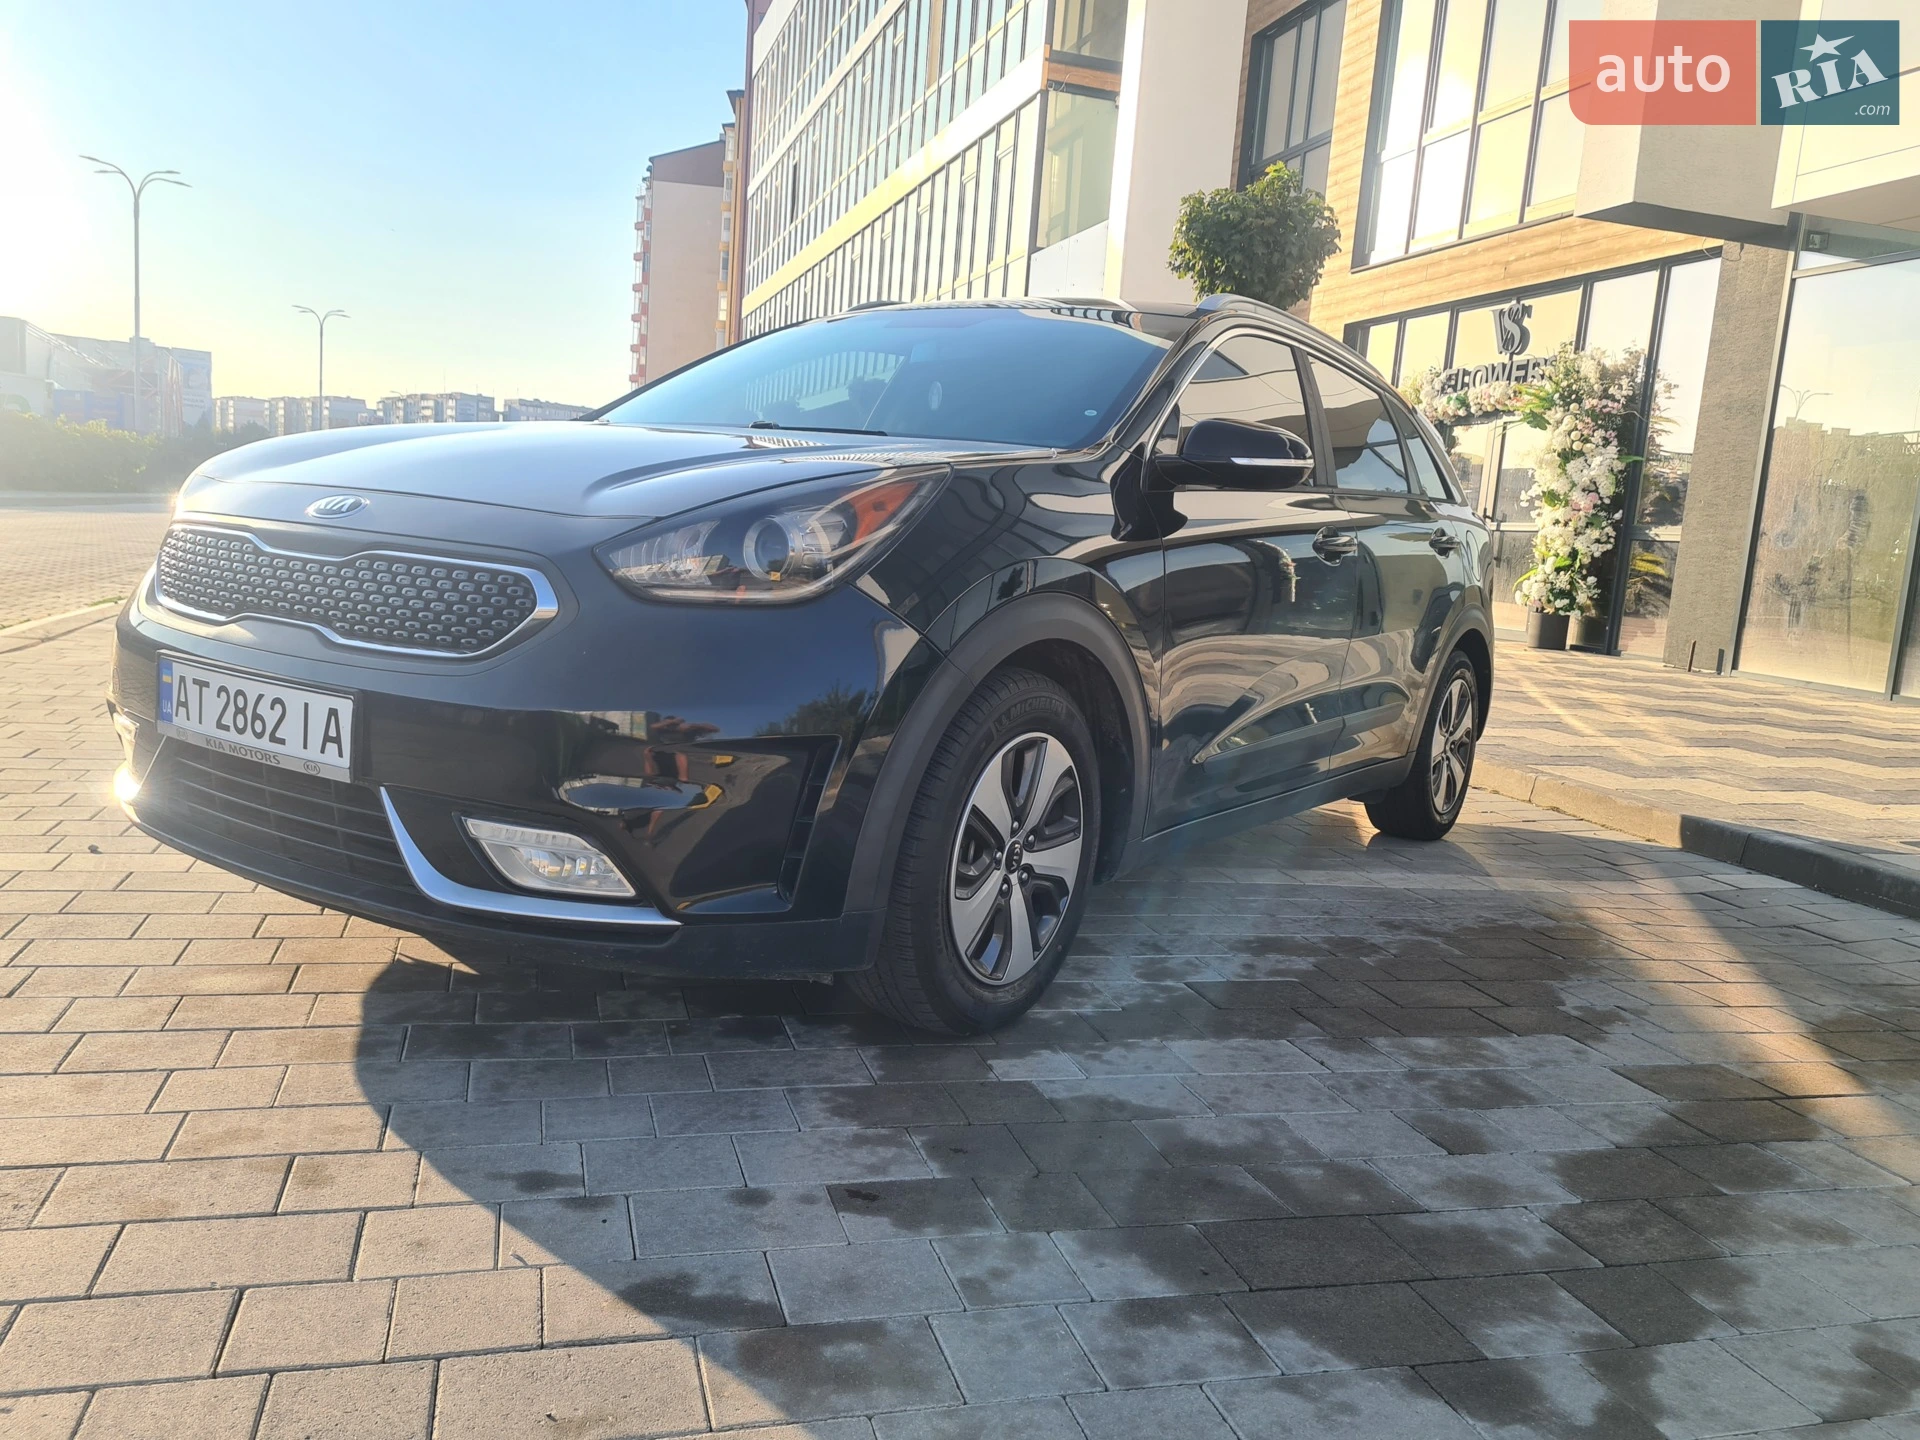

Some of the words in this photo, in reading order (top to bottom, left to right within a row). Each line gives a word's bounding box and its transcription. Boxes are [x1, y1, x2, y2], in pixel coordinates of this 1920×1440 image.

[162, 700, 173, 714] UA
[175, 674, 210, 725] AT
[215, 684, 288, 747] 2862
[302, 701, 344, 759] IA
[1010, 697, 1065, 720] MICHELIN
[205, 737, 226, 752] KIA
[228, 744, 282, 766] MOTORS
[304, 761, 320, 774] KIA
[1010, 843, 1021, 870] KIA
